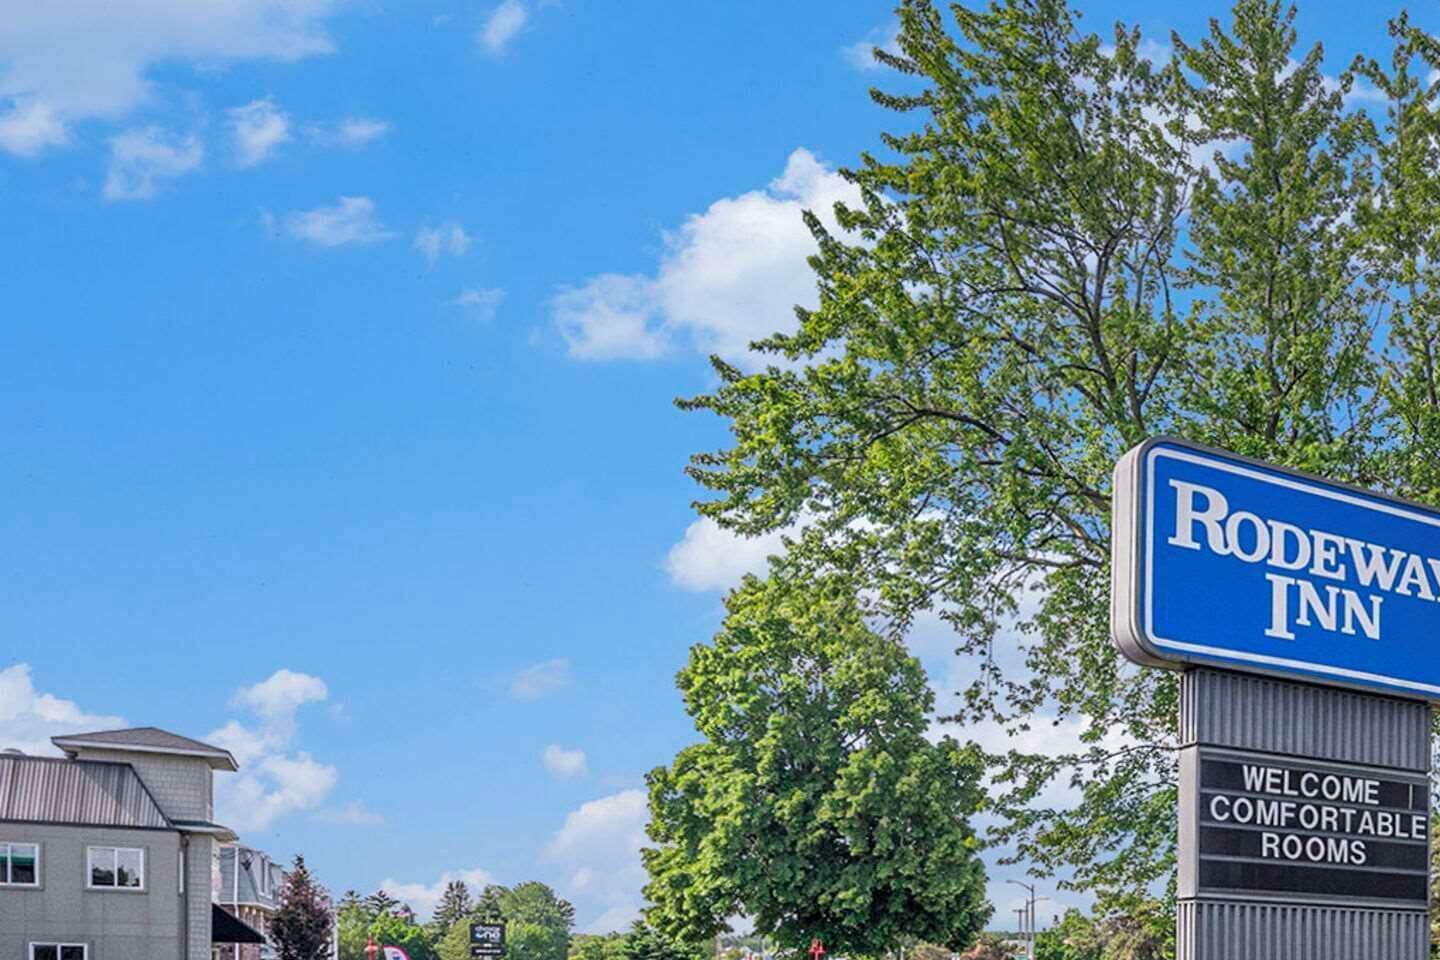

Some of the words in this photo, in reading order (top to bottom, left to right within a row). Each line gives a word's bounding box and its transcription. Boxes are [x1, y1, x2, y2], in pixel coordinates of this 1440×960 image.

[1264, 572, 1384, 640] INN
[1243, 765, 1380, 805] WELCOME
[1210, 795, 1428, 839] COMFORTABLE
[1262, 832, 1367, 865] ROOMS
